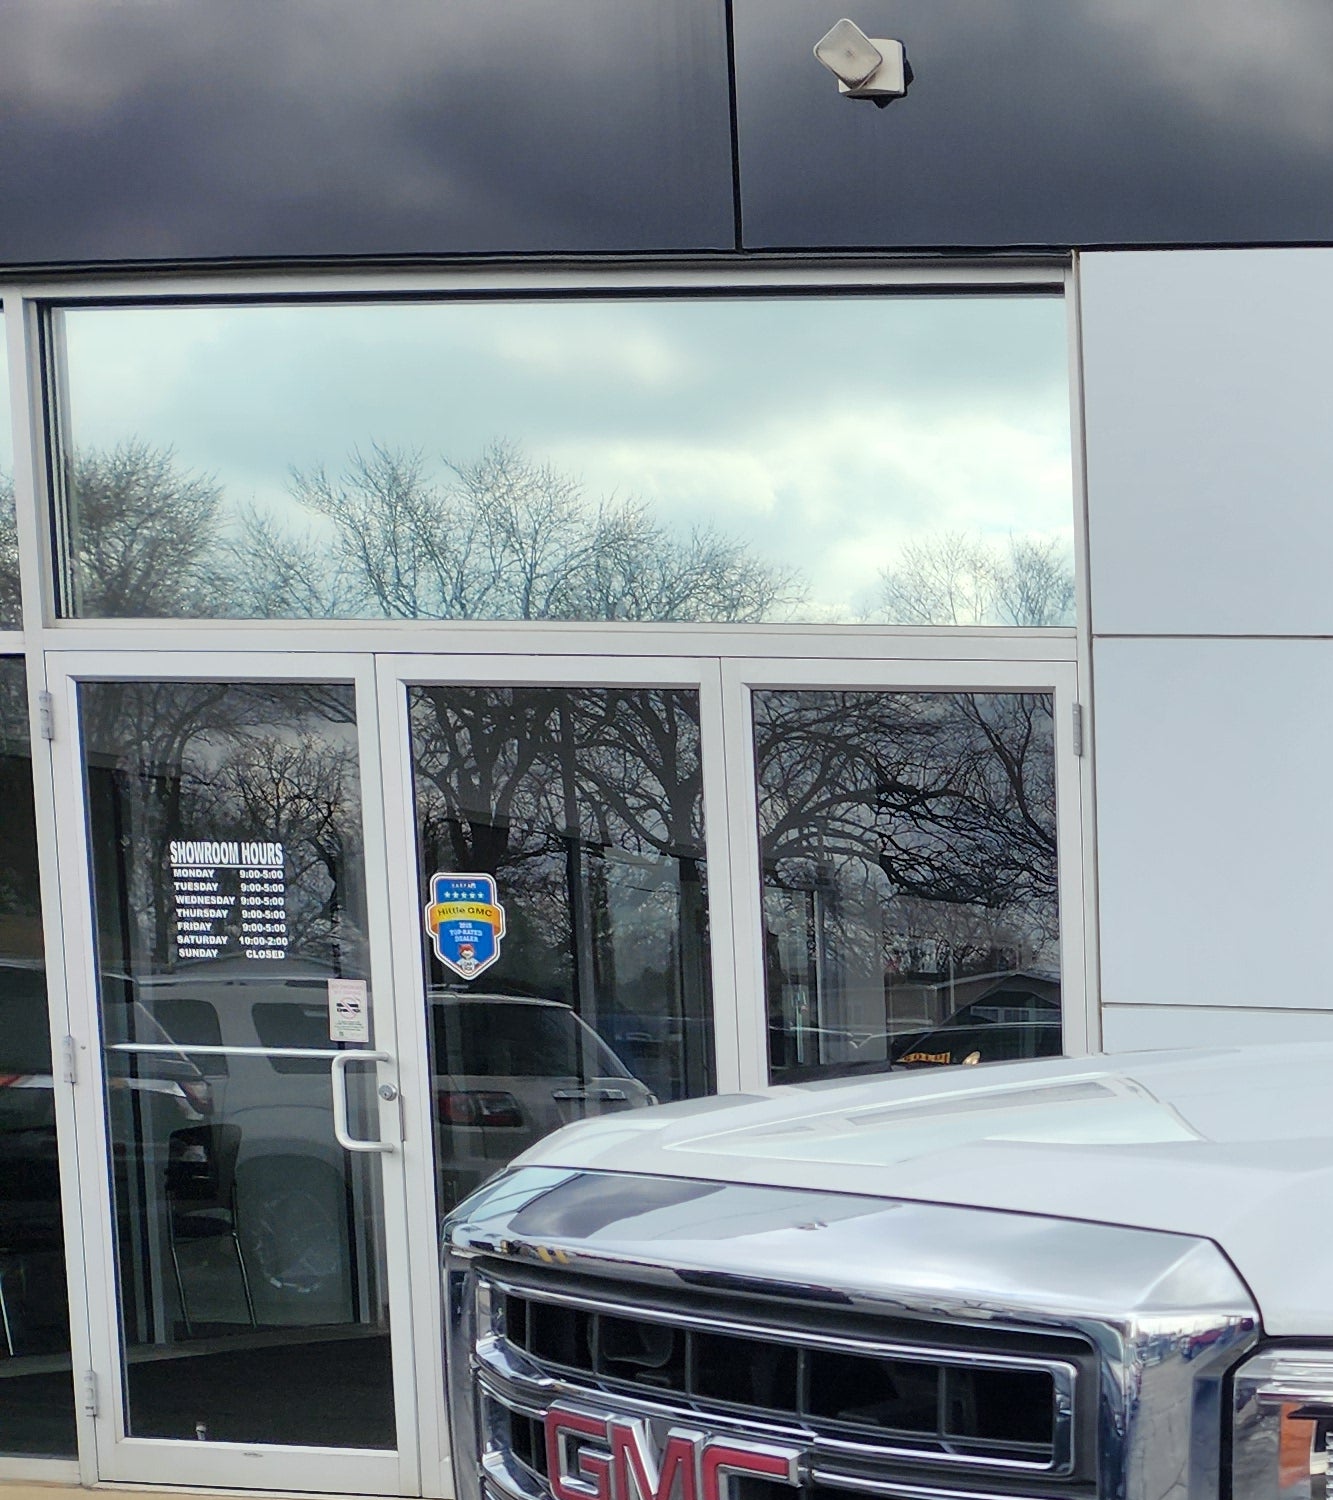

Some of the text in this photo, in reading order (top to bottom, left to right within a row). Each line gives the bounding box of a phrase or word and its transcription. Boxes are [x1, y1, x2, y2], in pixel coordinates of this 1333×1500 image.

[170, 841, 283, 865] SHOWROOM HOURS
[173, 868, 283, 879] MONDAY 9:00-5:00
[174, 881, 284, 893] TUESDAY 9:00-5:00
[175, 894, 284, 906] WEDNESDAY 9:00-5:00
[176, 908, 285, 919] THURSDAY 9:00-5:00
[467, 908, 492, 917] GMC
[177, 921, 286, 932] FRIDAY 9:00-5:00
[177, 935, 288, 946] SATURDAY 10:00-2:00
[179, 948, 285, 959] SUNDAY CLOSED
